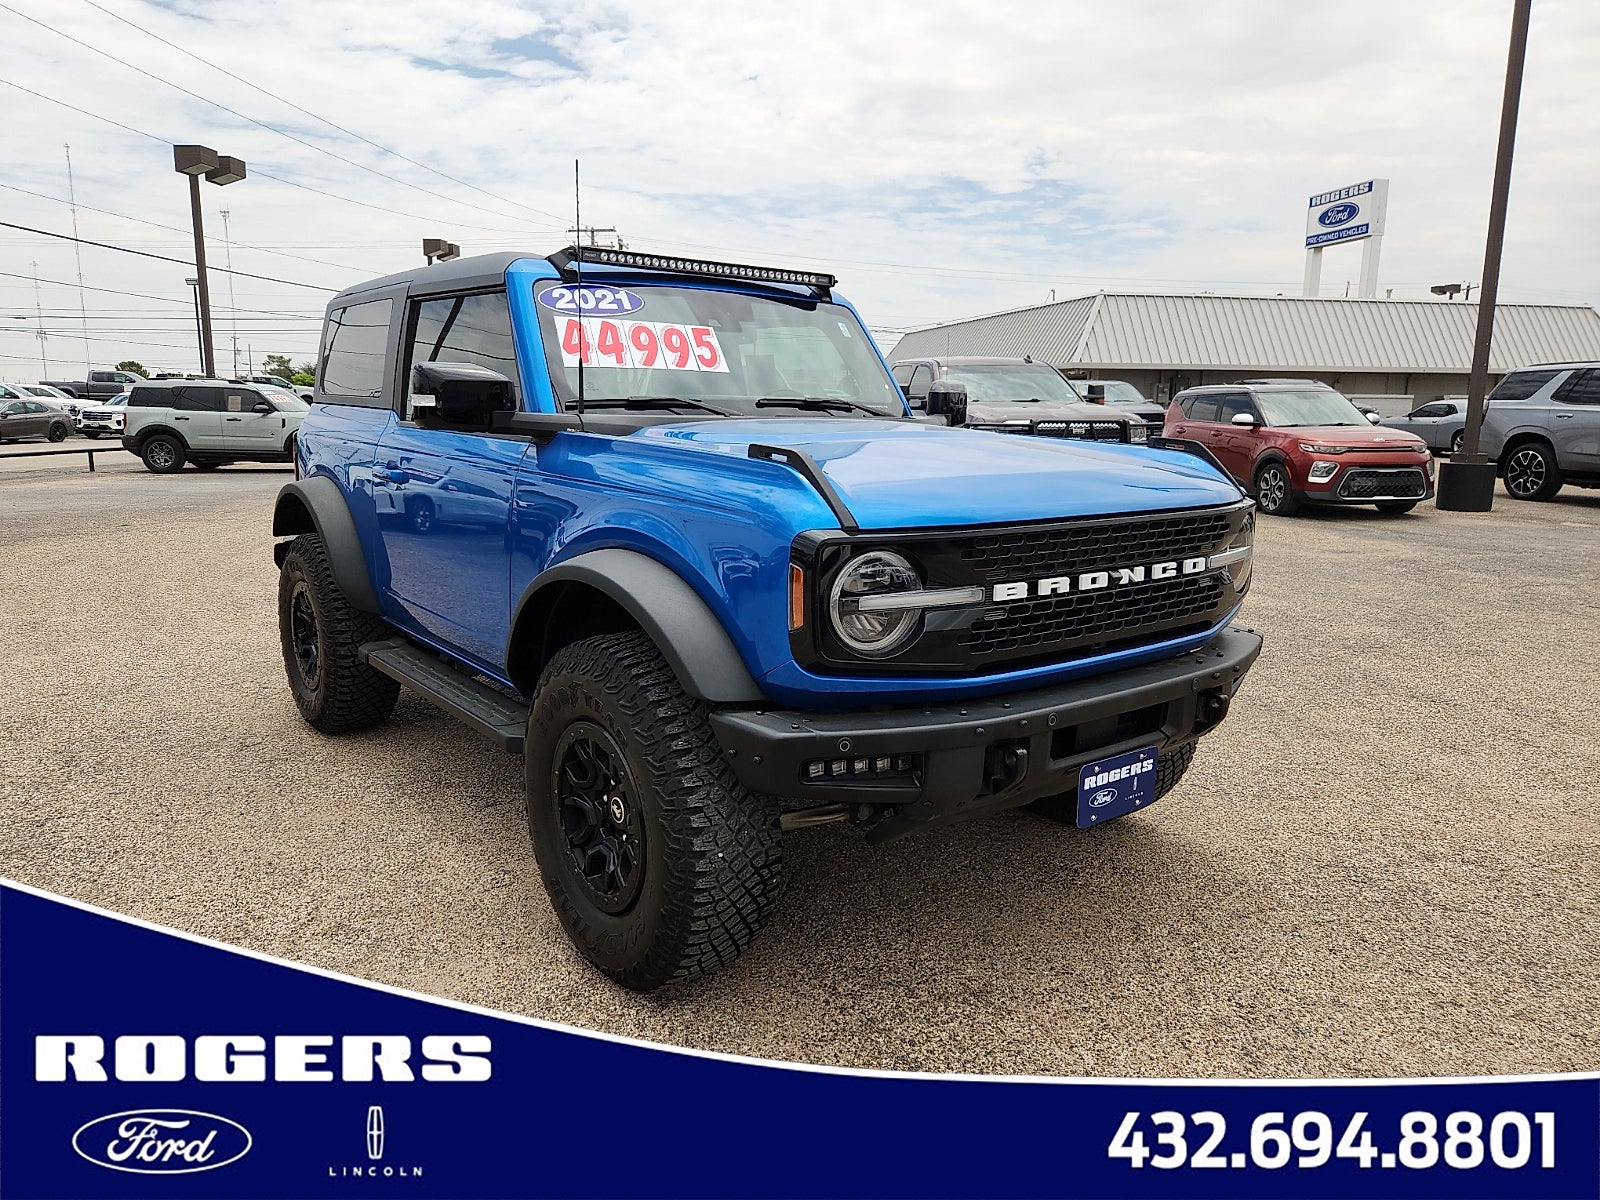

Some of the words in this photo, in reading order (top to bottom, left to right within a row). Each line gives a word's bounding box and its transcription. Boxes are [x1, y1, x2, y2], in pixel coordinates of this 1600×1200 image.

[1311, 182, 1369, 206] ROGERS
[1324, 206, 1350, 225] Ford
[1306, 233, 1339, 244] PRE-OWNED
[1339, 225, 1367, 237] VEHICLES
[551, 288, 633, 311] 2021
[562, 318, 721, 370] 44995
[992, 557, 1206, 602] BRONCO
[1084, 759, 1154, 790] ROGERS
[1093, 791, 1113, 806] Ford
